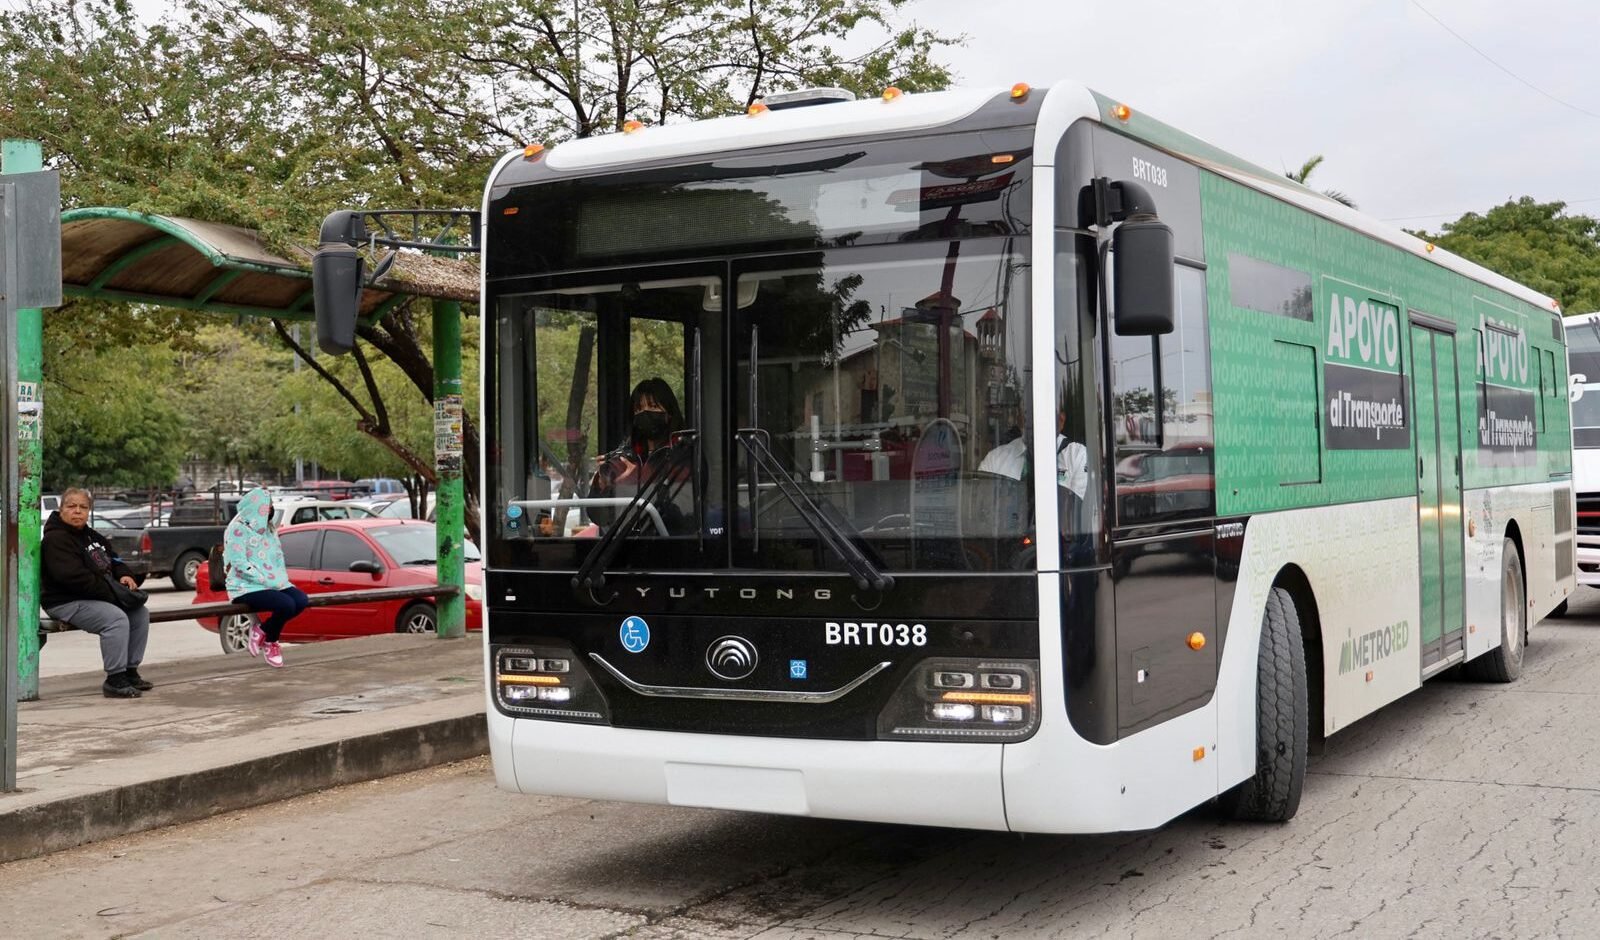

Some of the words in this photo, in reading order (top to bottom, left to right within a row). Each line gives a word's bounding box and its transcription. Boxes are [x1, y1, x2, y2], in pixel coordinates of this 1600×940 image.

[1132, 156, 1167, 188] BRT038
[1328, 292, 1399, 367] APOYO
[1476, 313, 1528, 385] APOYO
[1330, 390, 1342, 427] al
[1344, 392, 1403, 440] Transporte
[1490, 411, 1534, 457] Transporte
[636, 587, 832, 600] YUTONG
[825, 622, 927, 646] BRT038
[1352, 620, 1408, 671] METRORED
